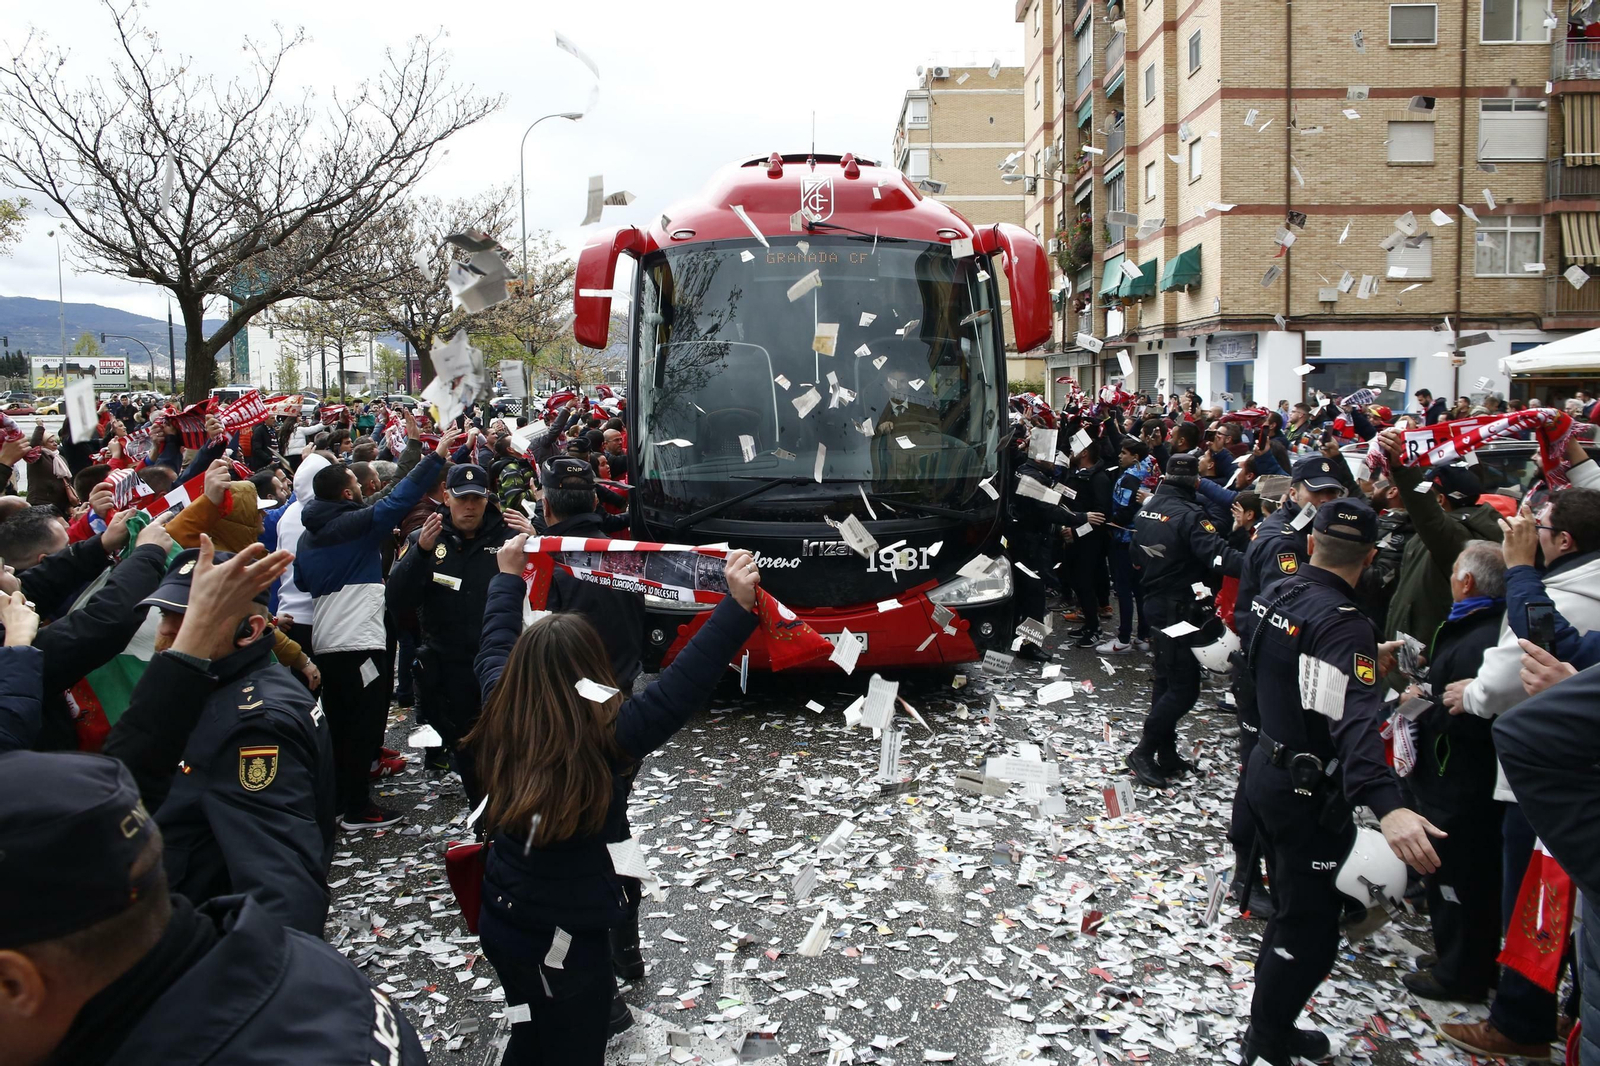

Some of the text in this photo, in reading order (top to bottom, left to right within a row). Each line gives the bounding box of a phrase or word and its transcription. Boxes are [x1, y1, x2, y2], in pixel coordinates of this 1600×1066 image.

[766, 252, 868, 264] GRANADA CF
[1338, 512, 1358, 521] CNP
[752, 550, 802, 569] oreno
[612, 578, 634, 591] CUANDO
[634, 583, 647, 593] MÁS
[654, 587, 679, 600] NECESITE
[1312, 860, 1338, 870] CNP
